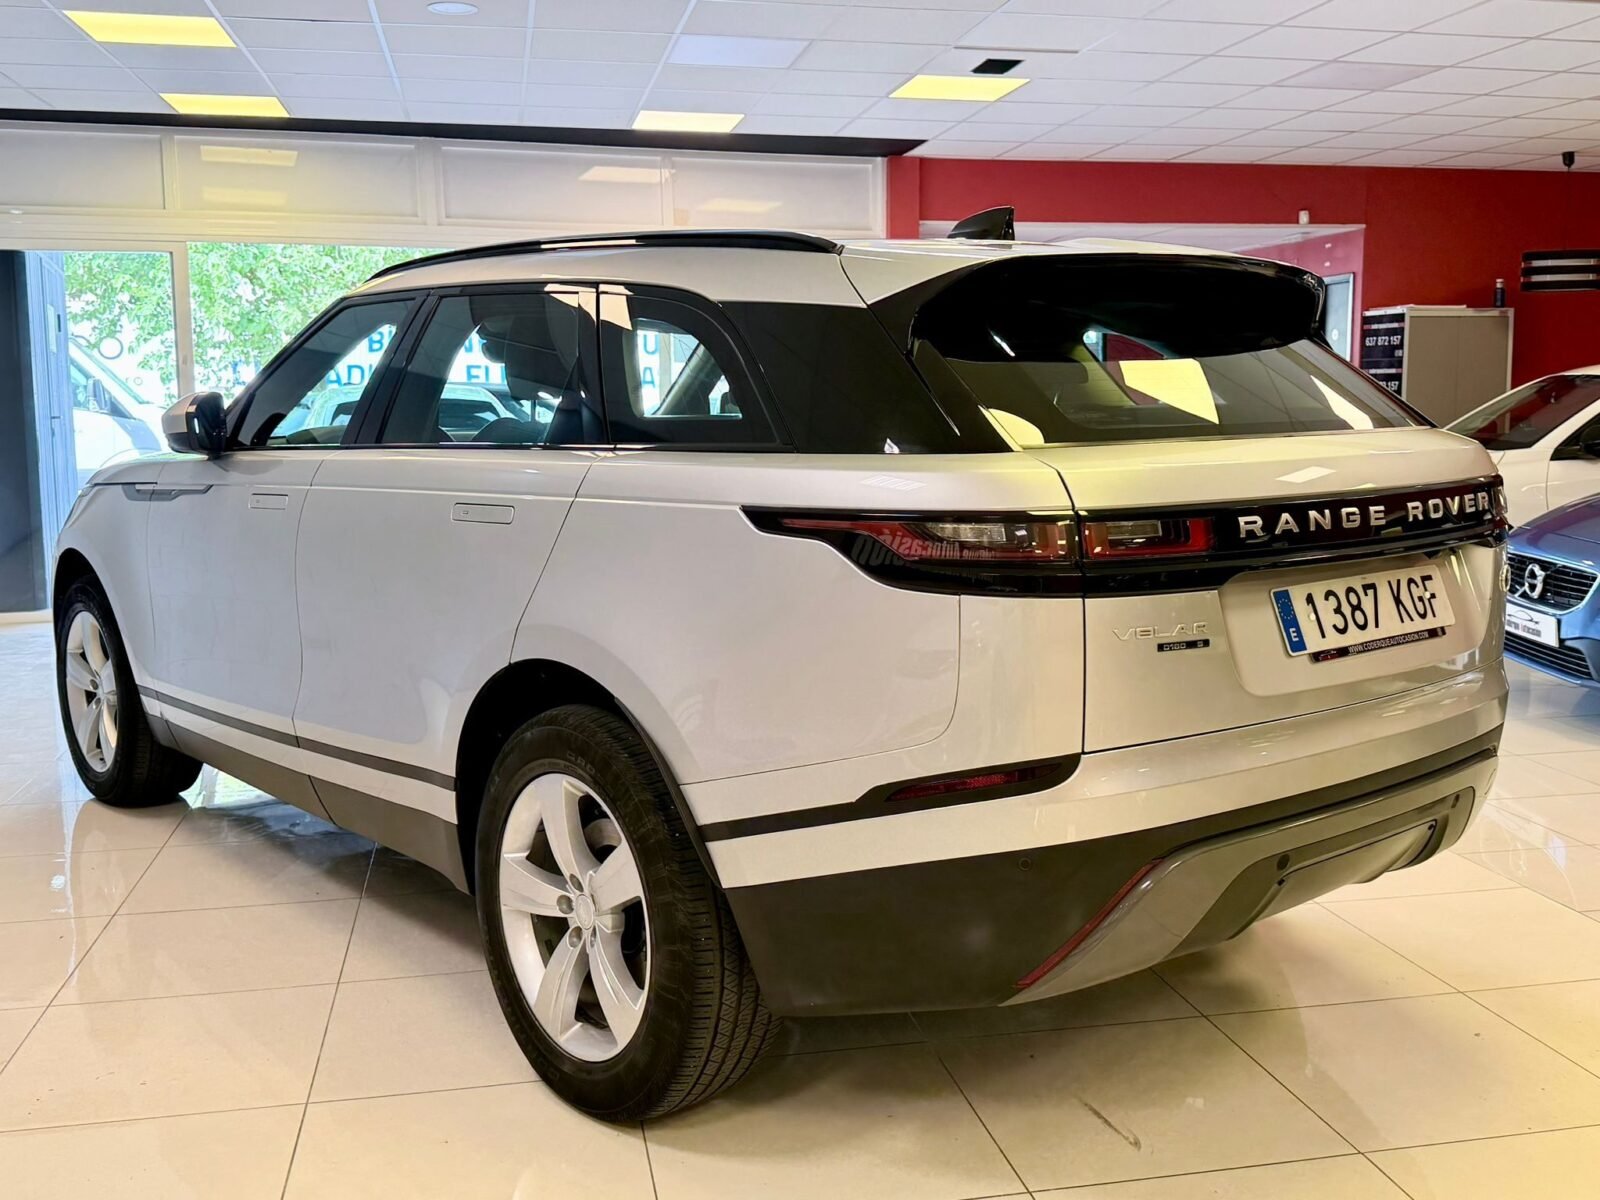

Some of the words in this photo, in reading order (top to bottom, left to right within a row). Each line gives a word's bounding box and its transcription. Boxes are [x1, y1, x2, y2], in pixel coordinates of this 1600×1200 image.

[1237, 505, 1387, 538] RANGE
[1406, 491, 1490, 522] ROVER
[1305, 582, 1380, 639] 1387
[1387, 574, 1437, 624] KGF
[1112, 621, 1208, 641] VELAR
[1289, 627, 1299, 642] E
